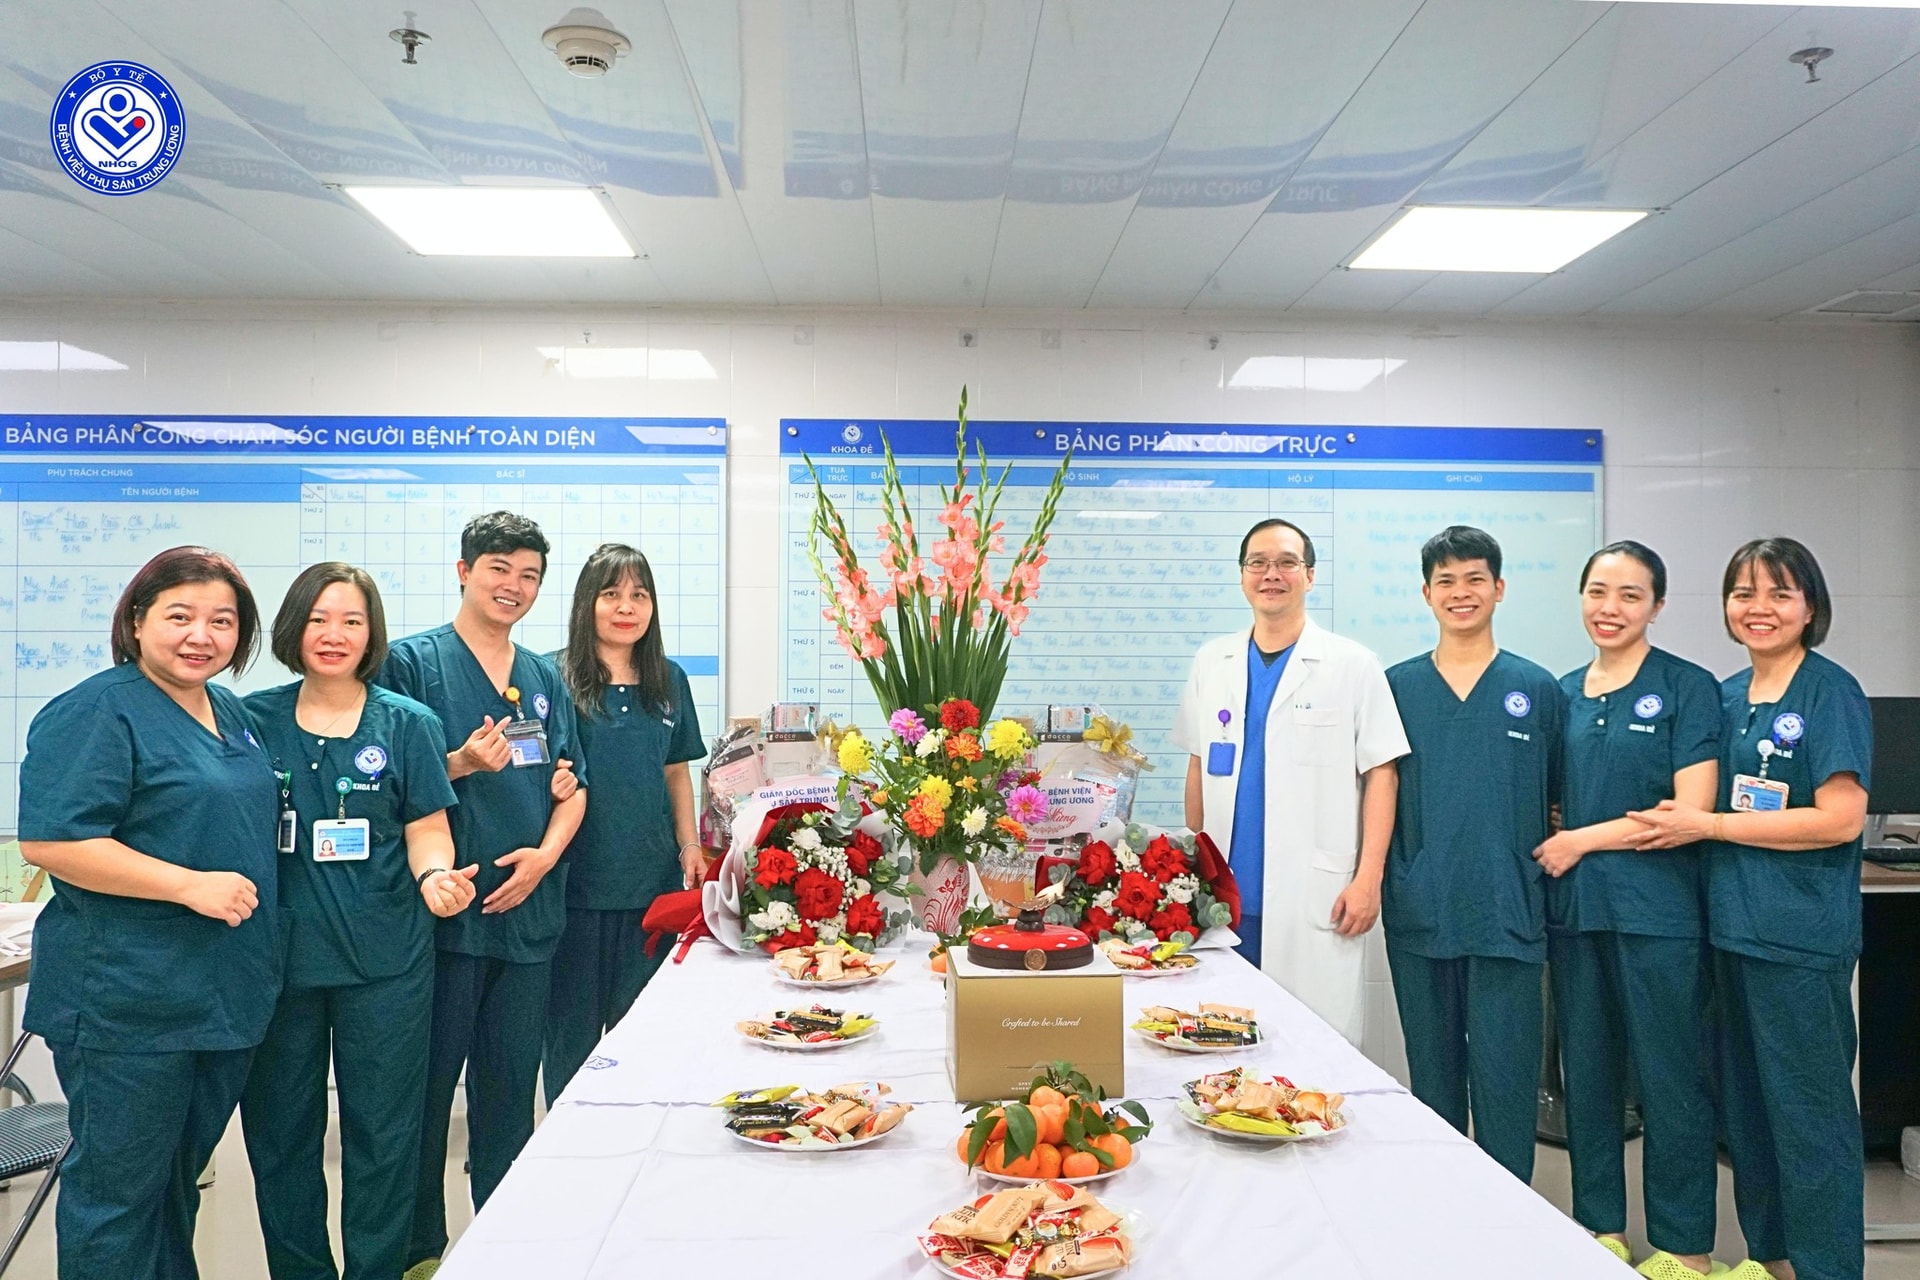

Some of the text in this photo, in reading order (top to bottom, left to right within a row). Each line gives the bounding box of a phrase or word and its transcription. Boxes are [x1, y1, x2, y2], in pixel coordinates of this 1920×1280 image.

[6, 422, 596, 450] BẢNG PHÂN CÔNG CHĂM SÓC NGƯỜI BỆNH TOÀN DIỆN
[1055, 428, 1337, 457] BẢNG PHÂN CÔNG TRỰC
[831, 444, 873, 454] KHOA ĐẺ
[47, 467, 133, 478] PHỤ TRÁCH CHUNG
[496, 469, 525, 479] BÁC SĨ
[871, 470, 884, 480] BÁ
[1078, 473, 1100, 481] SINH
[827, 474, 849, 482] TRỰC
[1288, 473, 1302, 484] HỘ
[1446, 475, 1460, 483] GHI
[122, 487, 200, 498] TÊN NGƯỜI BỆNH
[829, 662, 844, 670] ĐÊM
[352, 782, 370, 791] KHOA
[1048, 786, 1092, 796] BỆNH VIỆN
[759, 790, 784, 799] GIÁM
[785, 787, 805, 797] ĐỐC
[807, 786, 830, 796] BỆNH
[799, 796, 829, 804] TRUNG
[1069, 796, 1094, 805] ƯƠNG
[1001, 1016, 1082, 1030] Crafted to be Shared
